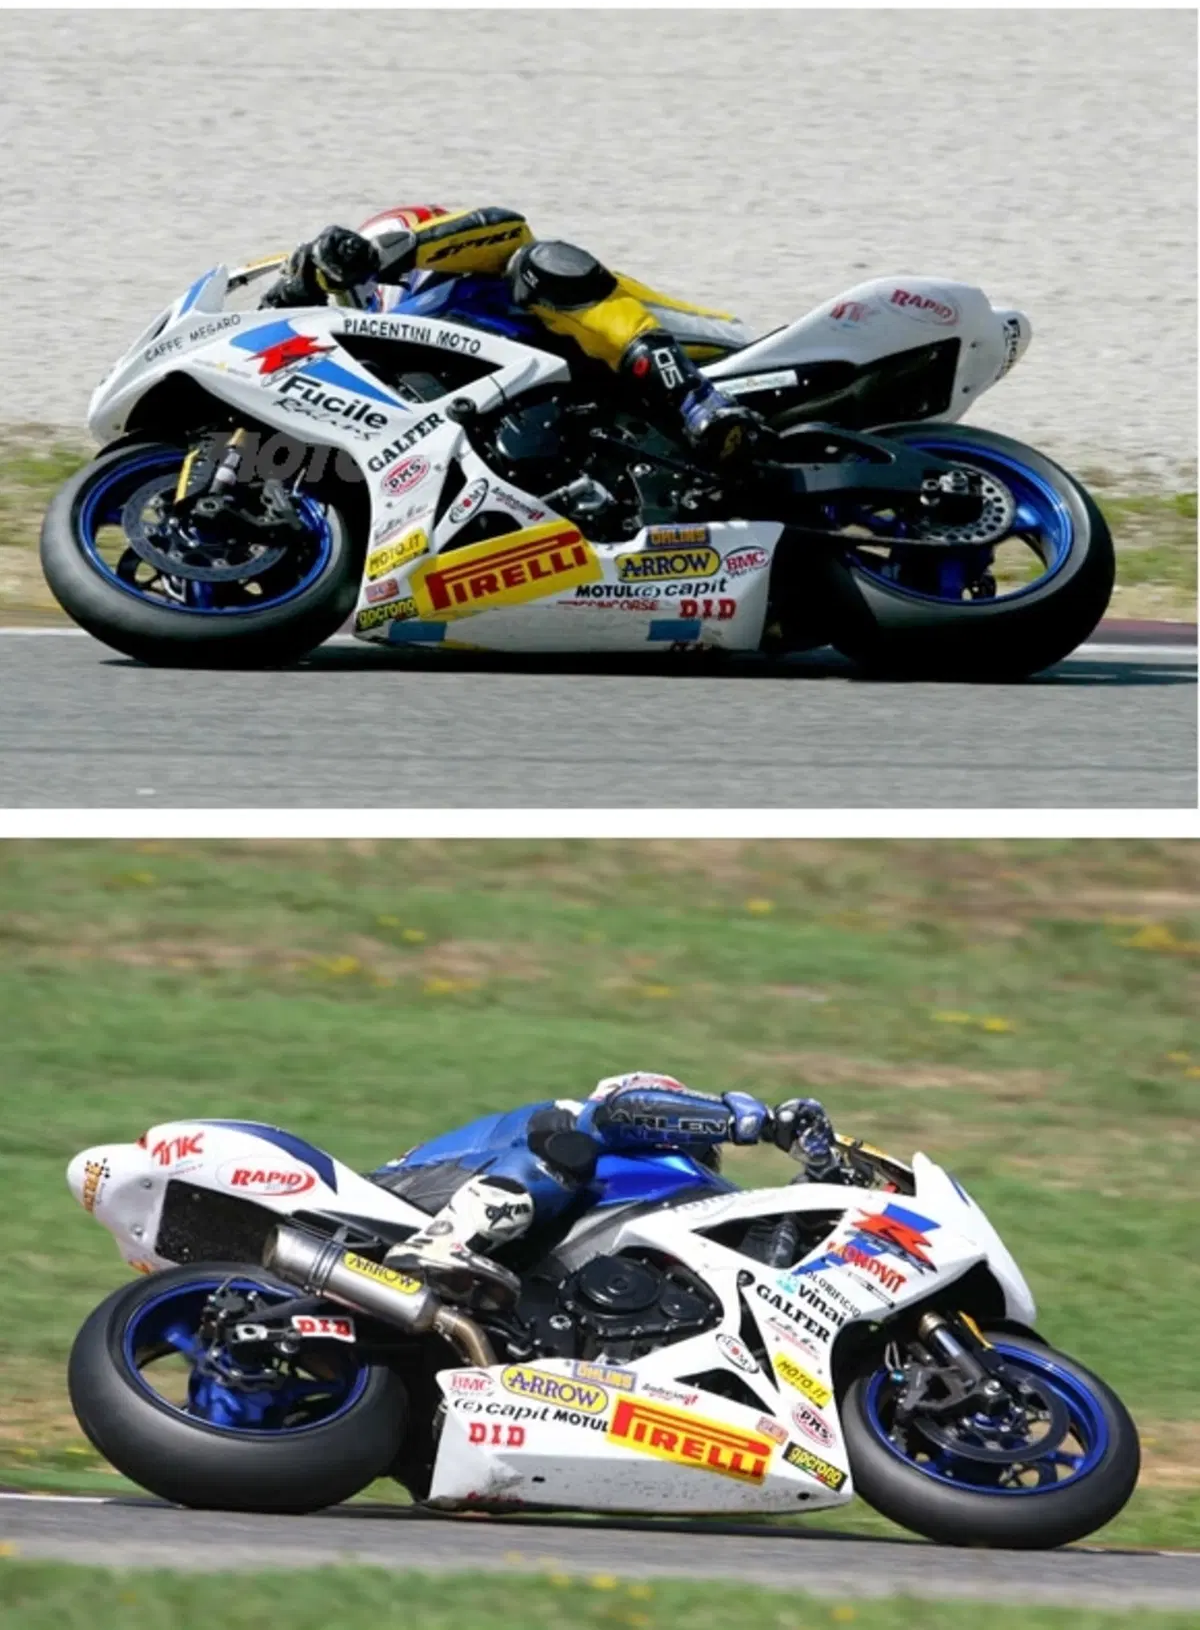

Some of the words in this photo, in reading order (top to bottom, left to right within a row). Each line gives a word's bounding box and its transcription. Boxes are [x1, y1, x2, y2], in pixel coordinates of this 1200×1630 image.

[189, 314, 242, 341] MEGARO
[344, 319, 431, 343] PIACENTINI
[438, 329, 481, 354] MOTO
[279, 374, 389, 430] Fucile
[368, 412, 444, 472] GALFER
[389, 458, 422, 489] PMS
[424, 530, 589, 610] PIRELLI
[622, 552, 711, 578] ARROW
[726, 550, 767, 572] BMC
[575, 584, 634, 598] MOTUL
[664, 577, 728, 598] capit
[348, 1256, 417, 1288] ARROW
[756, 1284, 831, 1343] GALFER
[508, 1371, 601, 1408] ARROW
[485, 1402, 550, 1422] capit
[552, 1408, 610, 1433] MOTUL
[800, 1410, 830, 1440] PMS
[610, 1399, 771, 1477] PIRELLI
